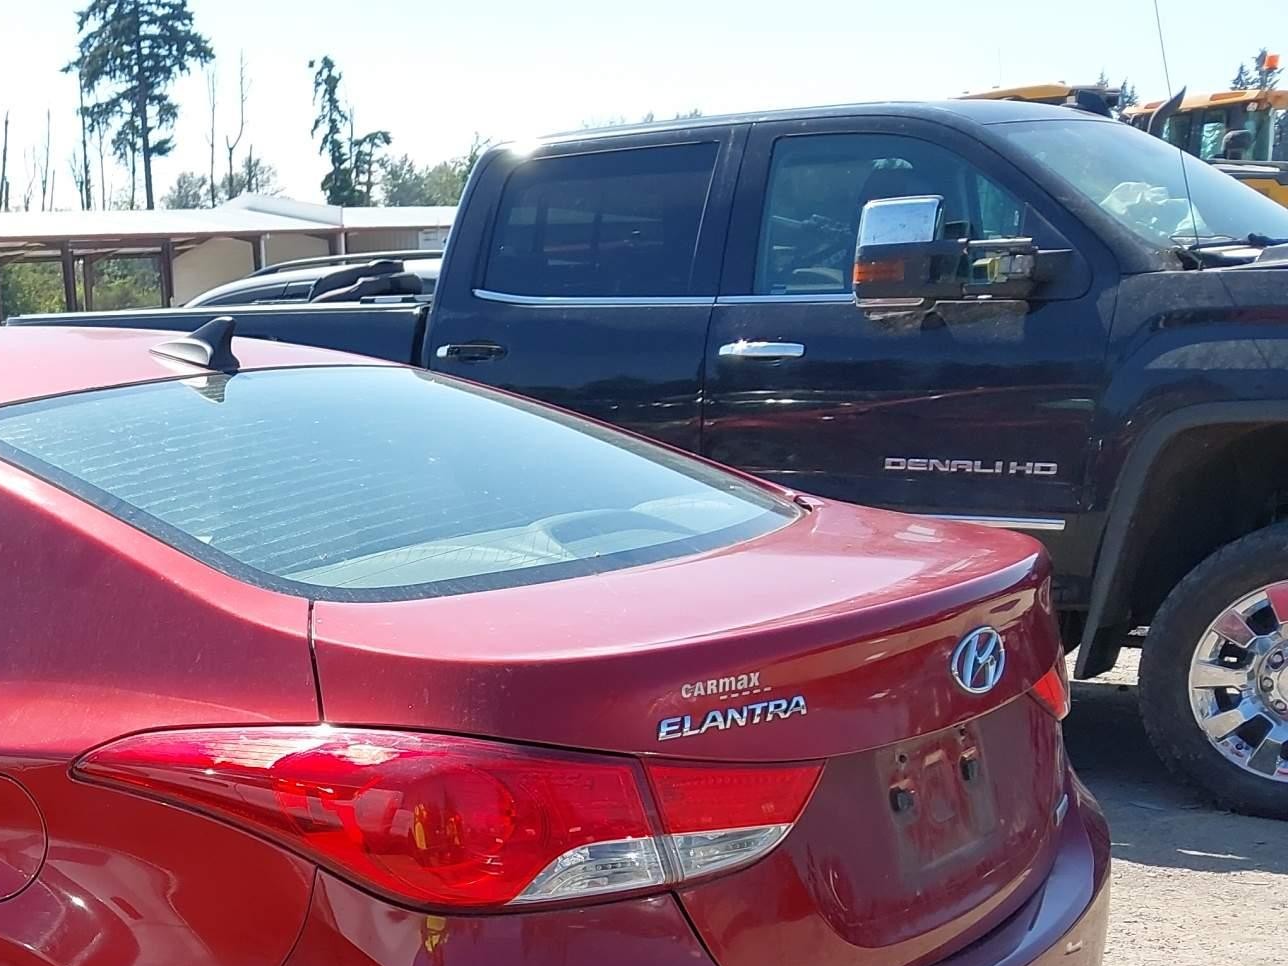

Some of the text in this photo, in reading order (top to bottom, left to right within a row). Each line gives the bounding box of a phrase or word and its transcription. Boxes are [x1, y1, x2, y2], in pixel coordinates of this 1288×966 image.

[884, 457, 1058, 475] DENALI HD
[658, 695, 808, 741] ELANTRA
